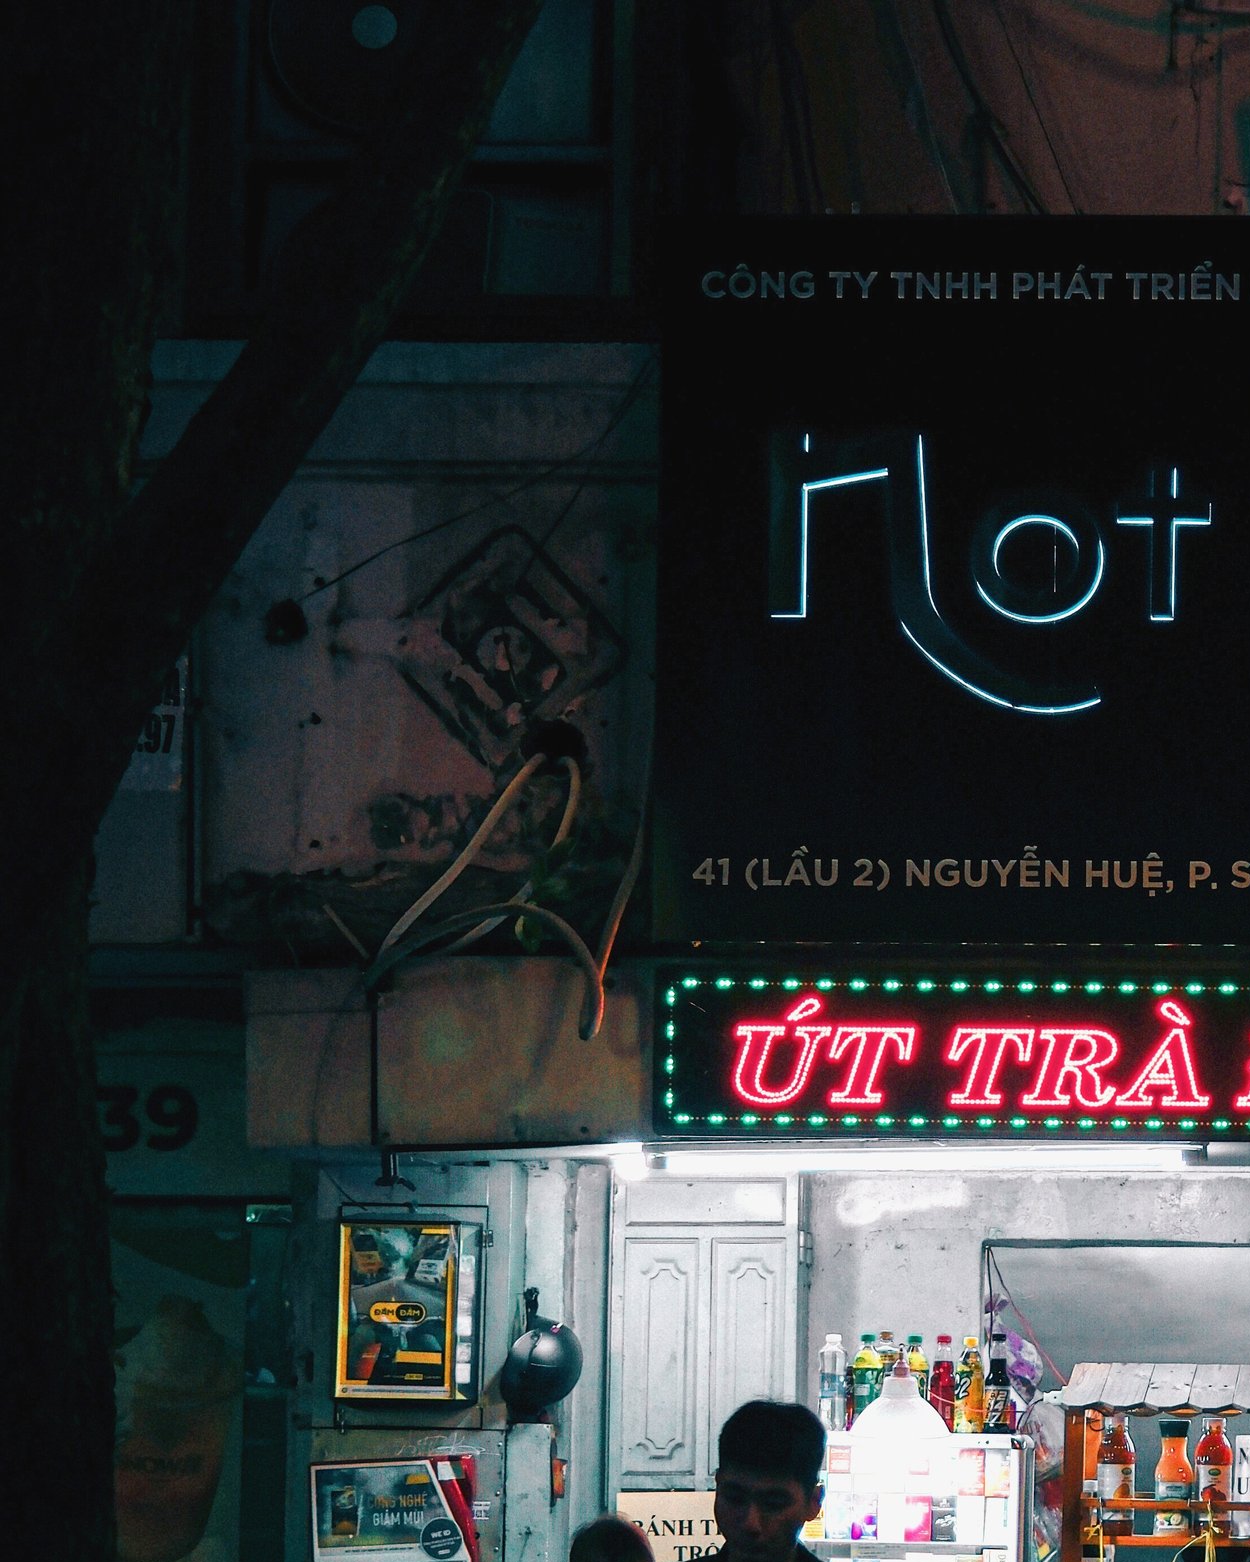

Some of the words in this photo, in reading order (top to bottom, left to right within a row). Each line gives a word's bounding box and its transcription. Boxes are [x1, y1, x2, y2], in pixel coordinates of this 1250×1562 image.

[701, 263, 816, 299] CÔNG
[828, 271, 879, 299] TY
[890, 271, 998, 300] TNHH
[1012, 263, 1113, 300] PHÁT
[1125, 260, 1241, 300] TRIỂN
[692, 857, 730, 887] 41
[744, 845, 839, 891] (LẦU
[852, 857, 892, 892] 2)
[905, 845, 1070, 888] NGUYỄN
[1085, 851, 1175, 897] HUỆ,
[1187, 860, 1218, 890] P.
[732, 996, 917, 1107] ÚT
[948, 1001, 1211, 1109] TRÀ
[96, 1085, 199, 1152] 39
